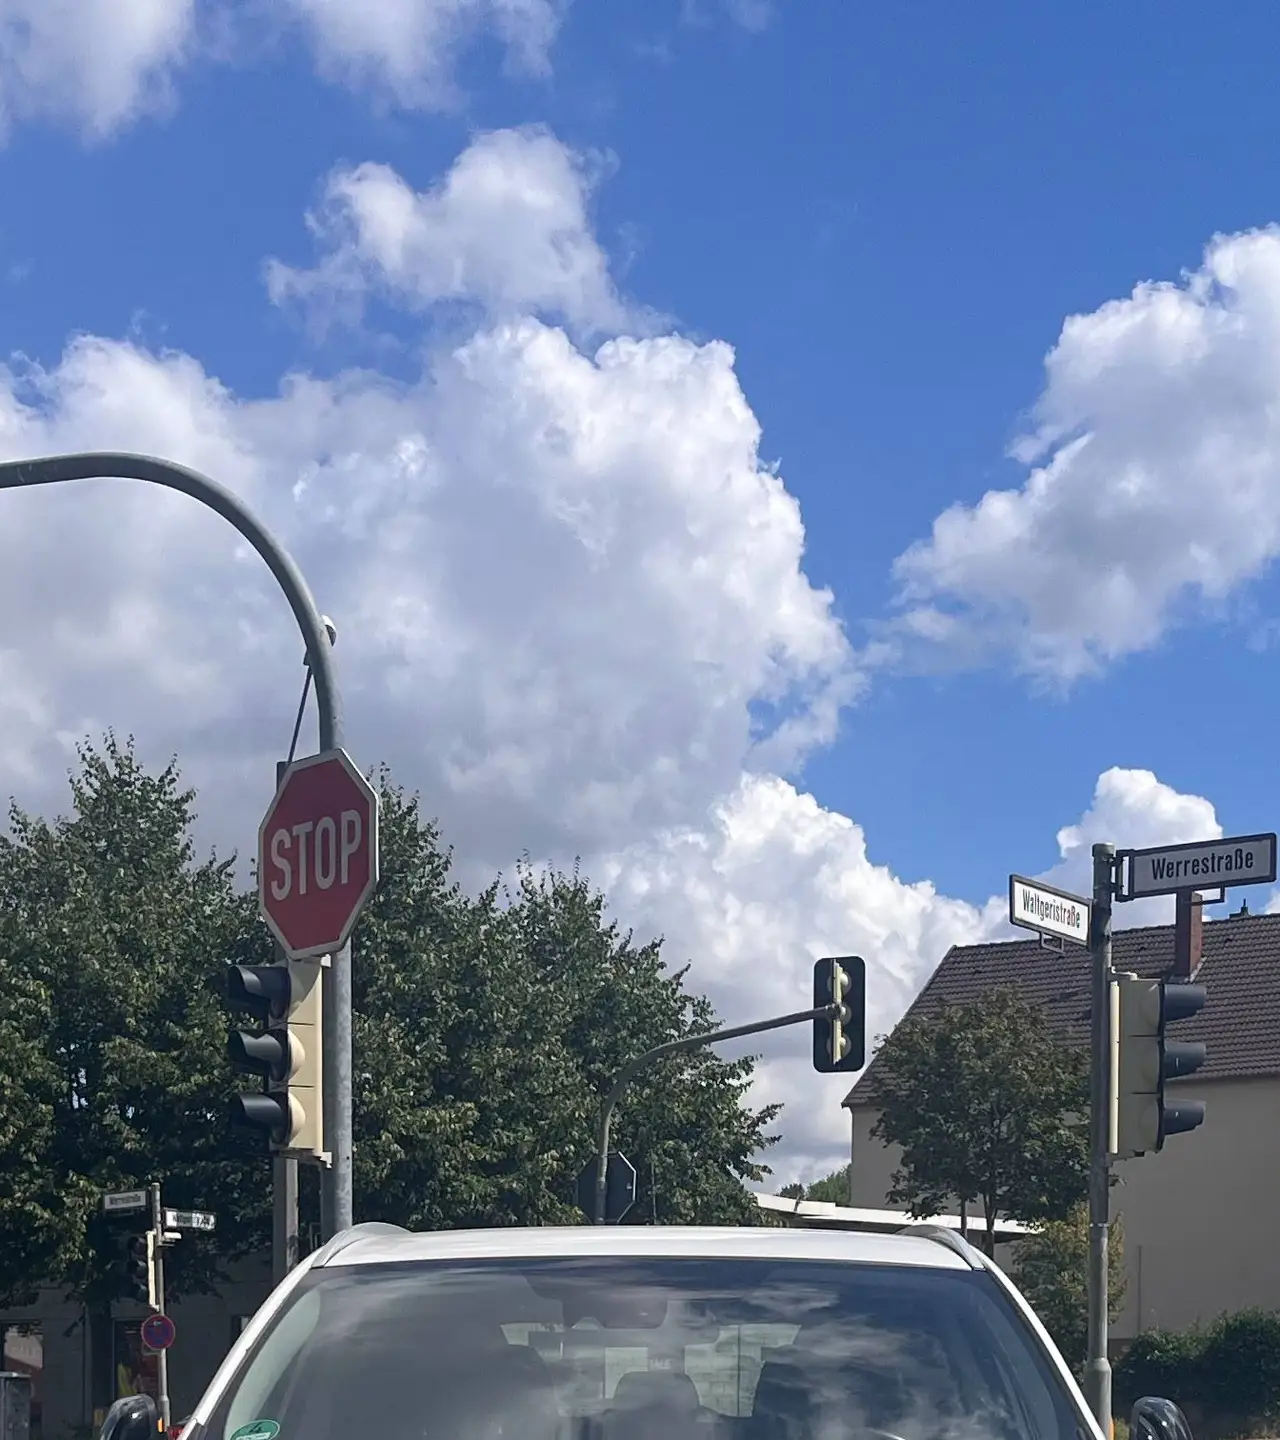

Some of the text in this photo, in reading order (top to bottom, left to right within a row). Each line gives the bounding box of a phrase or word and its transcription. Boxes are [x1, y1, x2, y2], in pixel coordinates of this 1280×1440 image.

[271, 809, 362, 901] STOP
[1152, 848, 1254, 880] Werrestraße
[1023, 888, 1080, 928] Waltgeristraße
